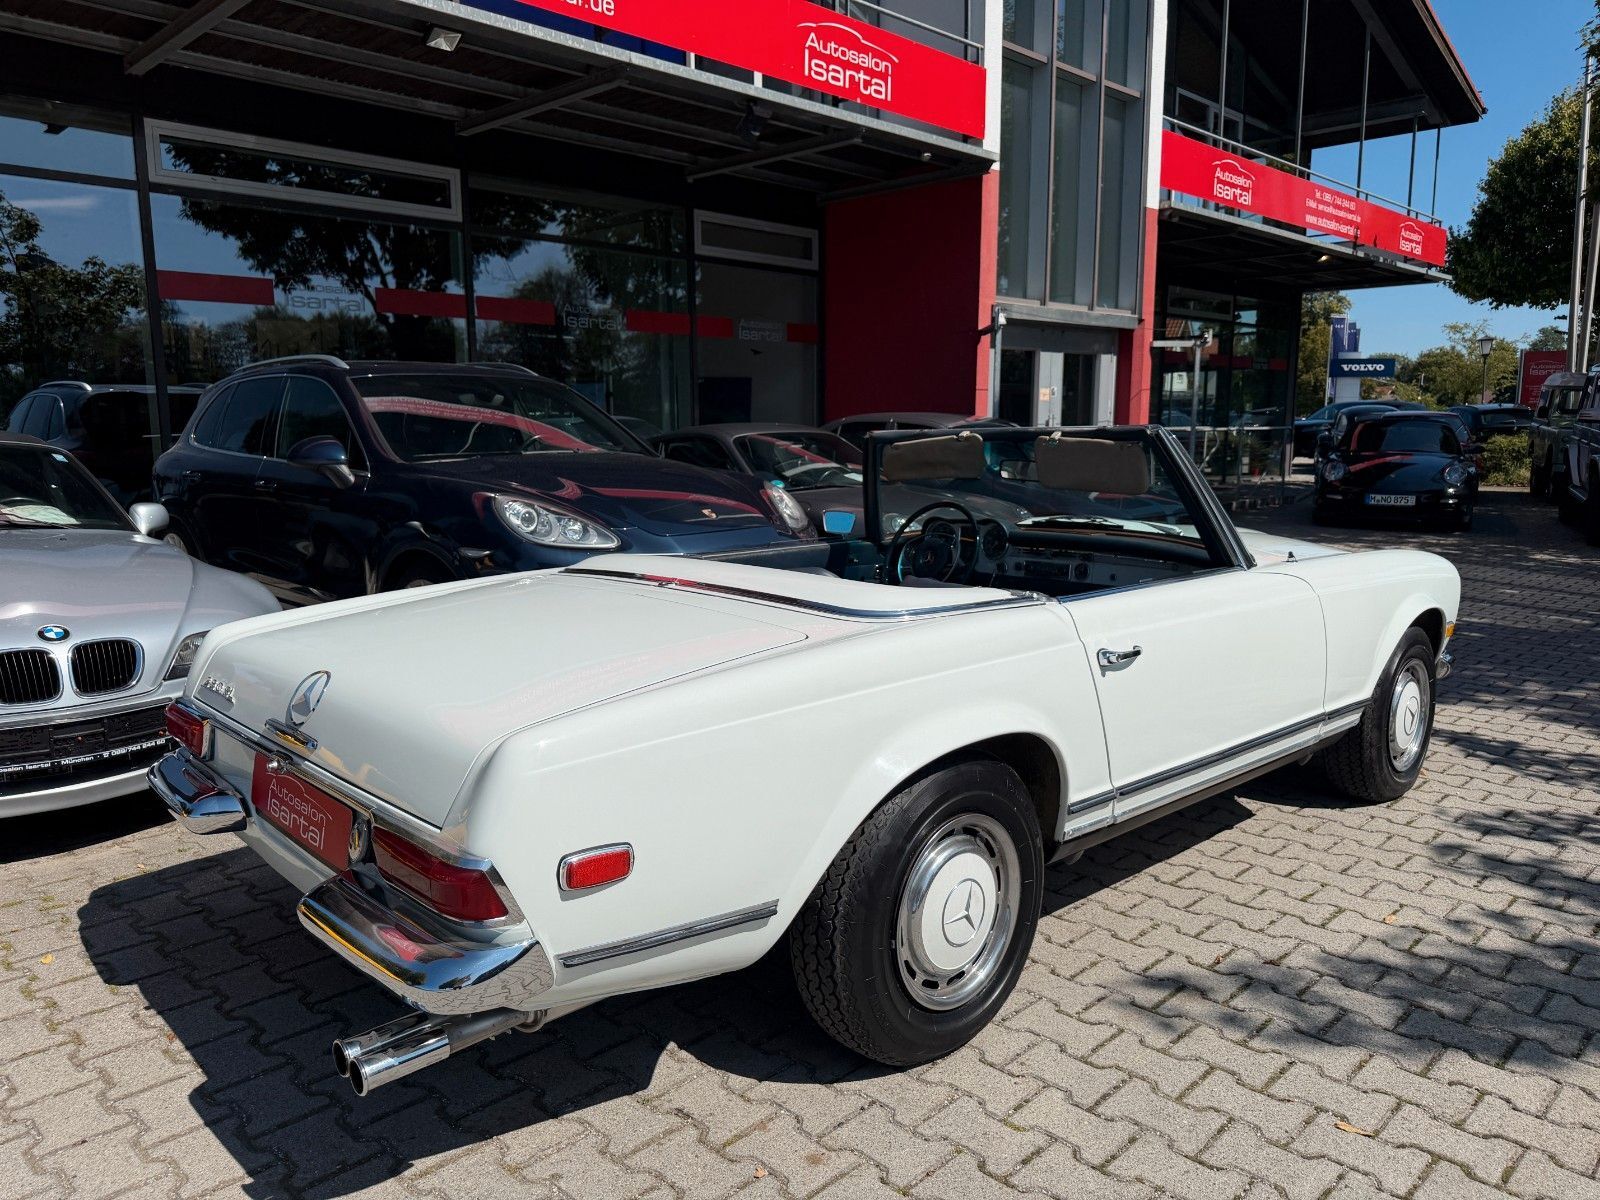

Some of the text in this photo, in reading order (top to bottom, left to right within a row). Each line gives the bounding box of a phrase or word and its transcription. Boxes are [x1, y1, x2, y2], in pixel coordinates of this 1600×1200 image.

[805, 32, 892, 75] Autosalon
[804, 48, 892, 101] Isartal
[1215, 167, 1253, 188] Autosalon
[1213, 177, 1253, 206] Isartal
[1399, 236, 1423, 255] Isartal
[1401, 227, 1423, 245] Autosalon
[1341, 363, 1385, 372] VOLVO
[1393, 495, 1409, 504] 875
[61, 756, 94, 765] München
[269, 778, 326, 827] Autosalon
[267, 789, 326, 850] Isartal
